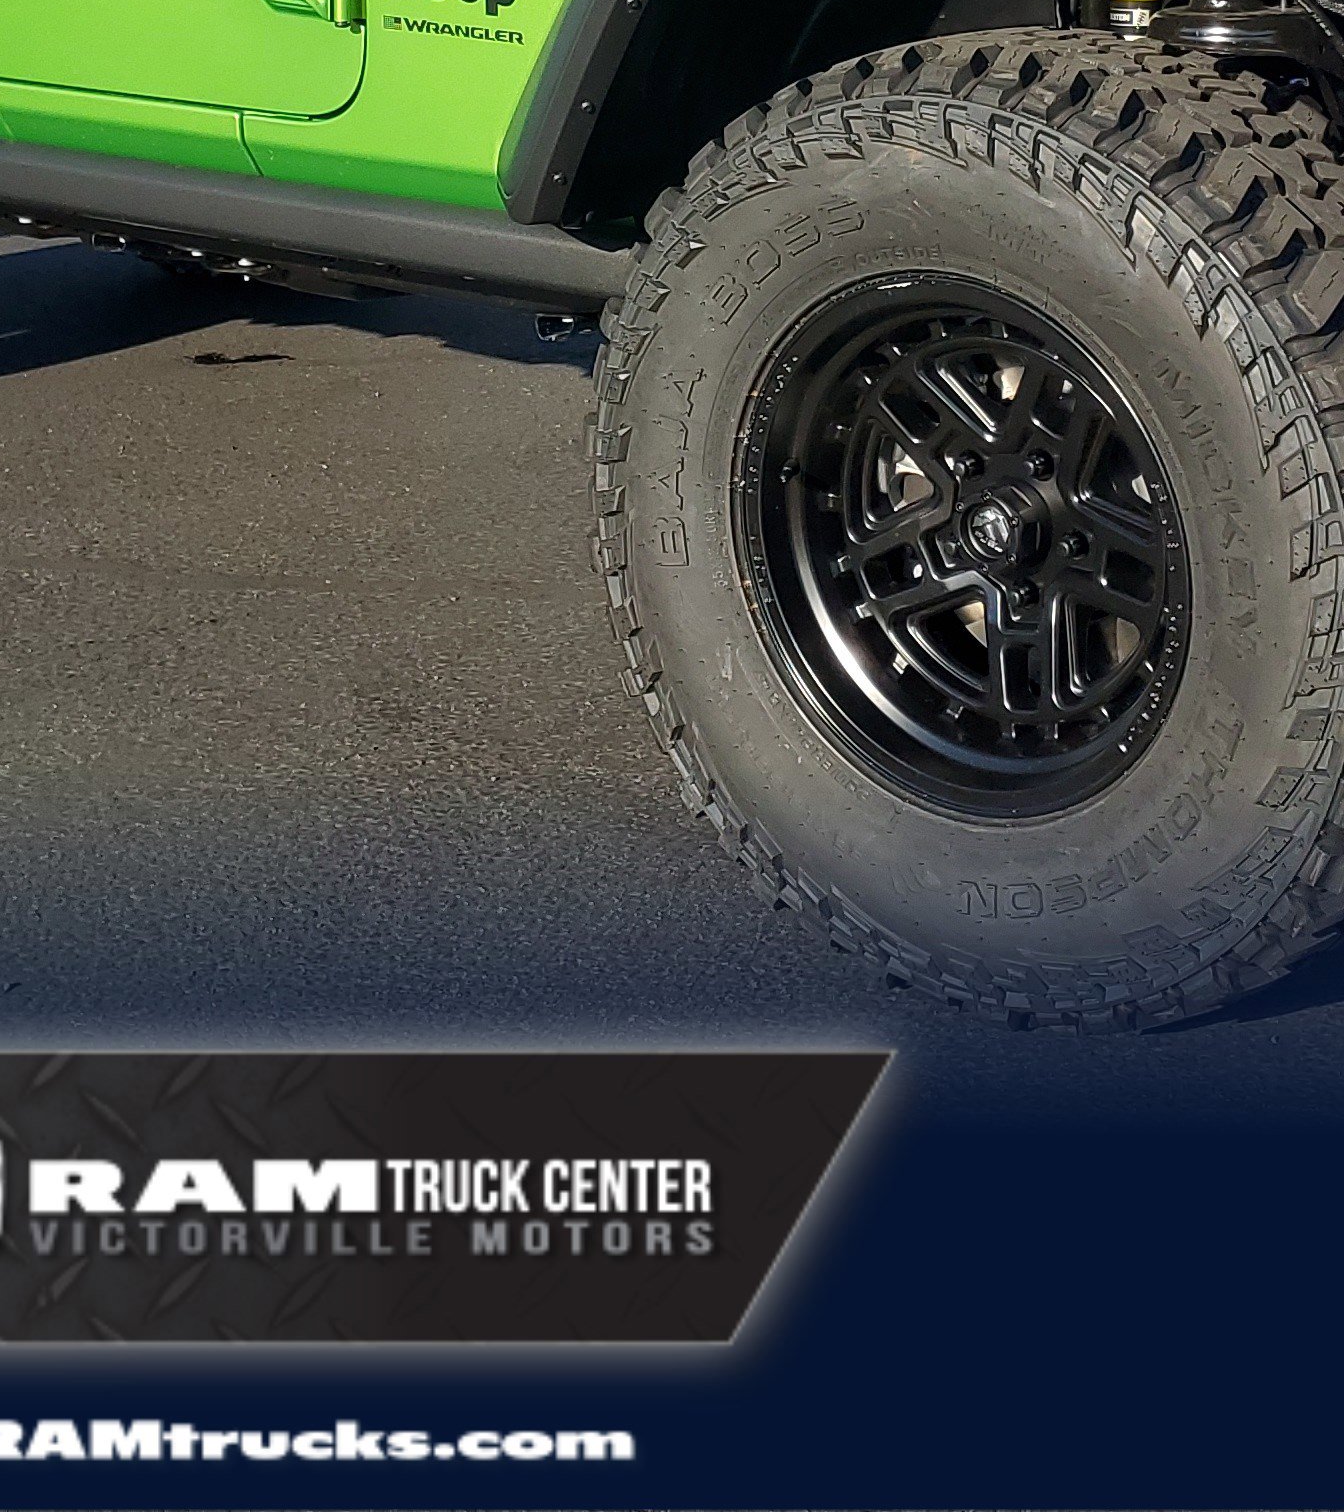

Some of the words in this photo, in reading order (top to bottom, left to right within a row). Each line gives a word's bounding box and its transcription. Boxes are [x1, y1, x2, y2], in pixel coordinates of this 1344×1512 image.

[403, 17, 525, 45] WRANGLER
[656, 367, 707, 568] BAJA
[709, 200, 865, 326] BOSS
[1157, 356, 1256, 660] MICKEY
[958, 716, 1246, 921] THOMPSON
